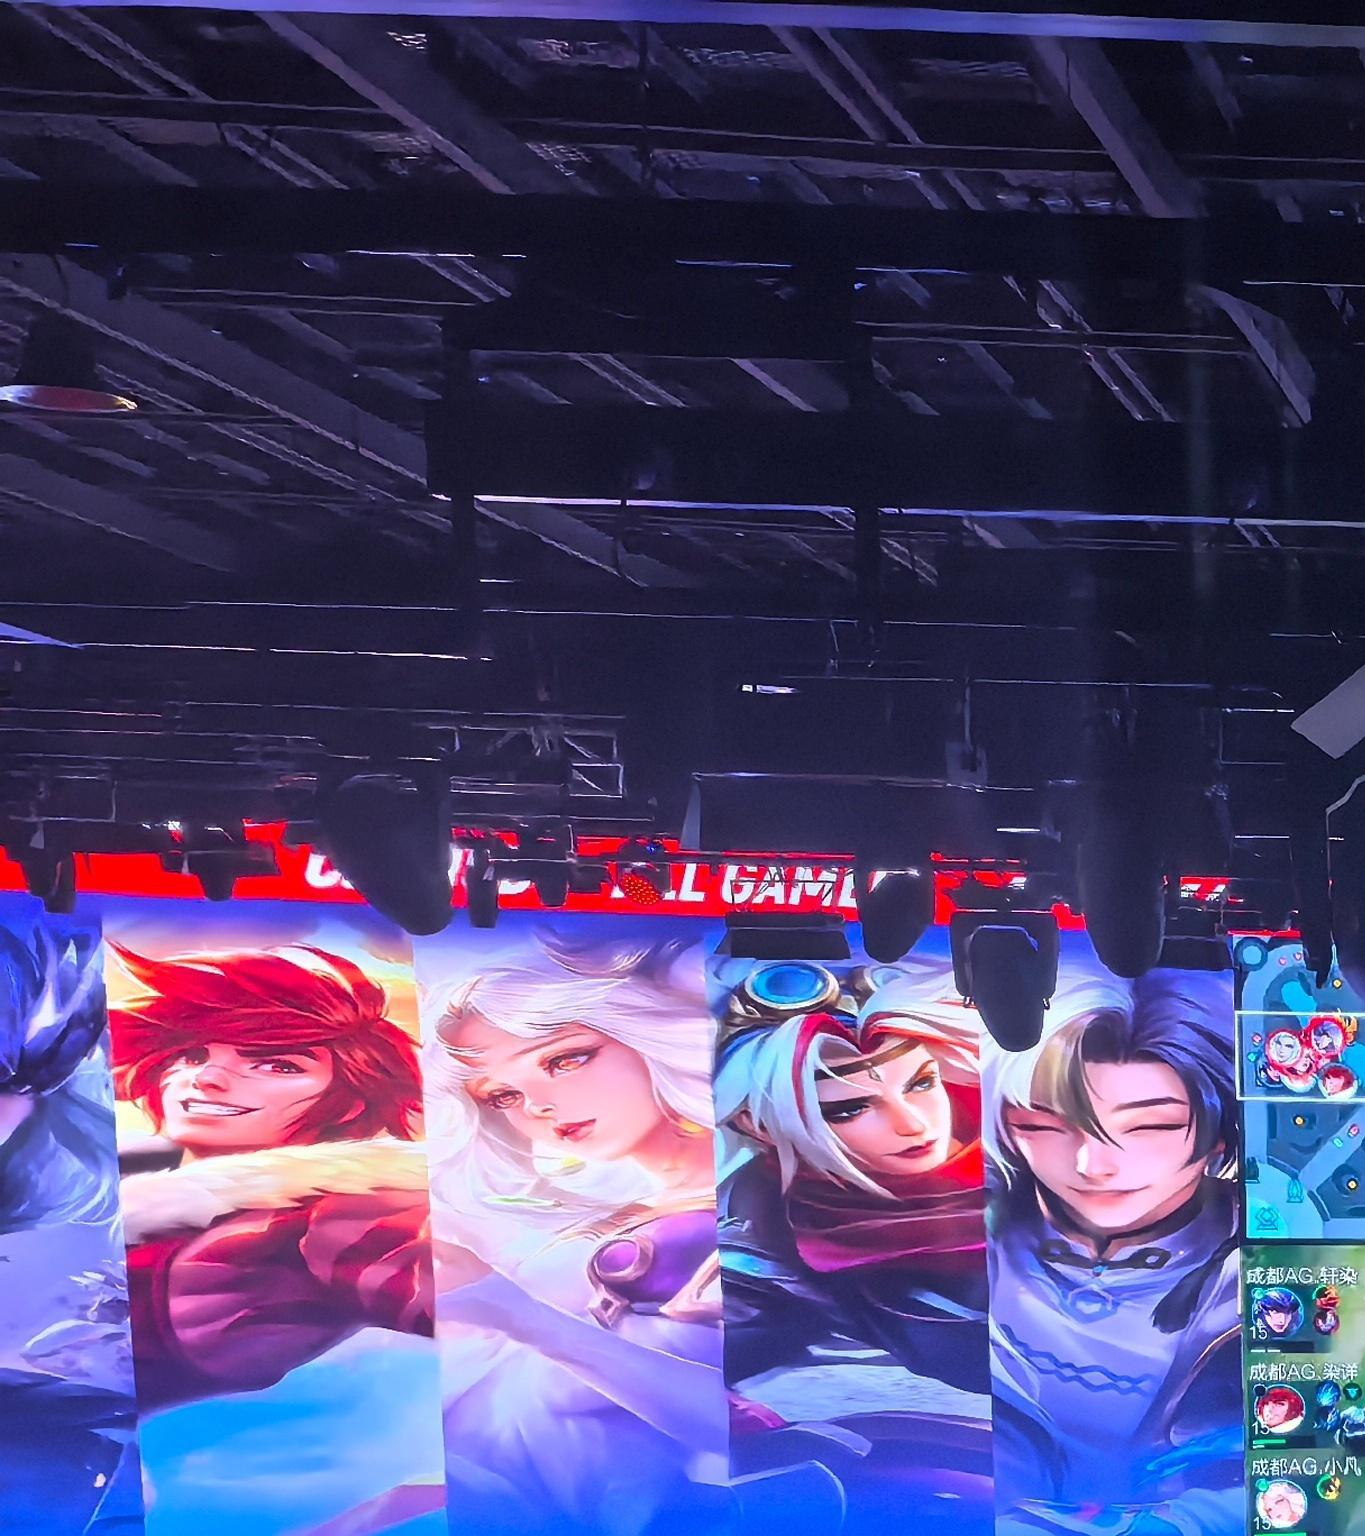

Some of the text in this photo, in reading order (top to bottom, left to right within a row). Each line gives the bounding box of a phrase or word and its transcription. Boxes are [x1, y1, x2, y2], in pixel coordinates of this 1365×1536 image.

[1249, 1325, 1269, 1341] 15
[1252, 1422, 1270, 1435] 15
[1253, 1516, 1272, 1531] 15
